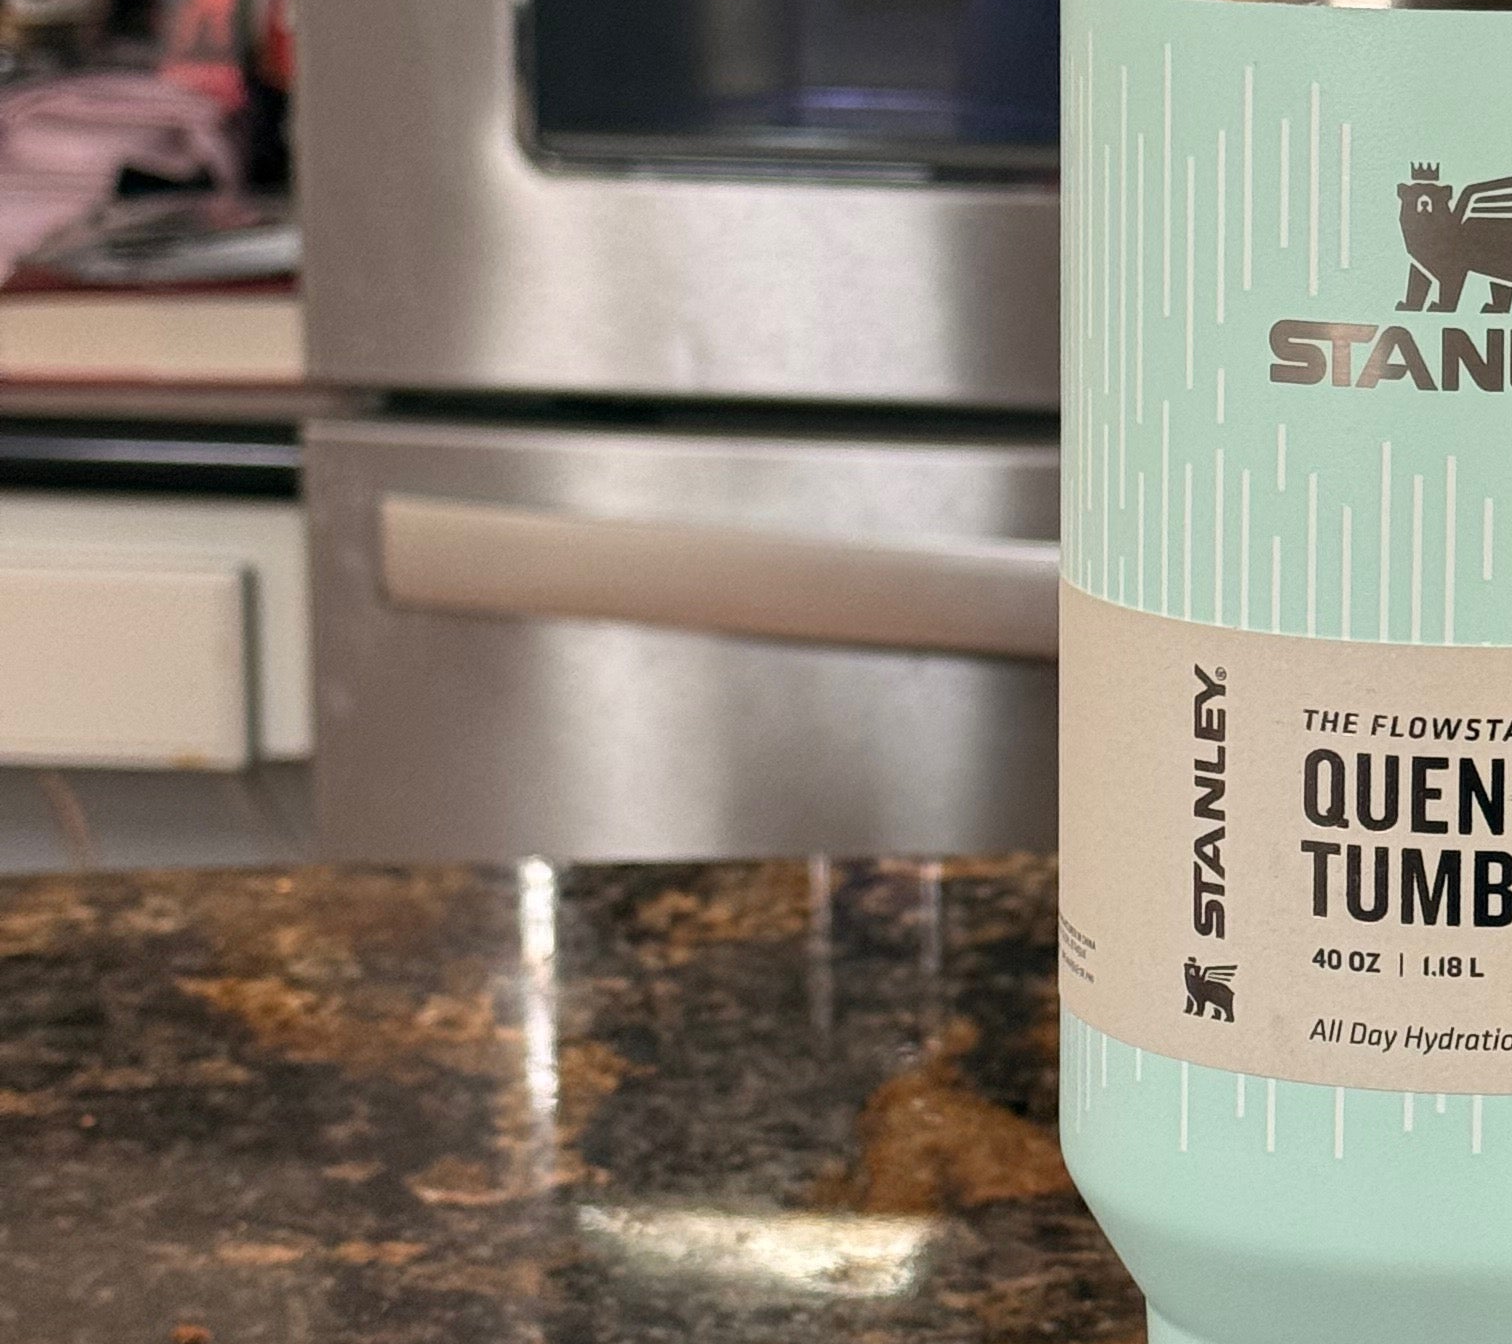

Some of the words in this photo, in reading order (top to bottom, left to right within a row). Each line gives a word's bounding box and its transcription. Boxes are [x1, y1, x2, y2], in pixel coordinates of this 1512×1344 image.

[1303, 708, 1359, 734] THE
[1312, 947, 1342, 970] 40
[1349, 951, 1381, 973] OZ
[1423, 956, 1462, 978] 1.18
[1470, 957, 1484, 978] L
[1309, 1018, 1343, 1043] All
[1350, 1022, 1398, 1053] Day
